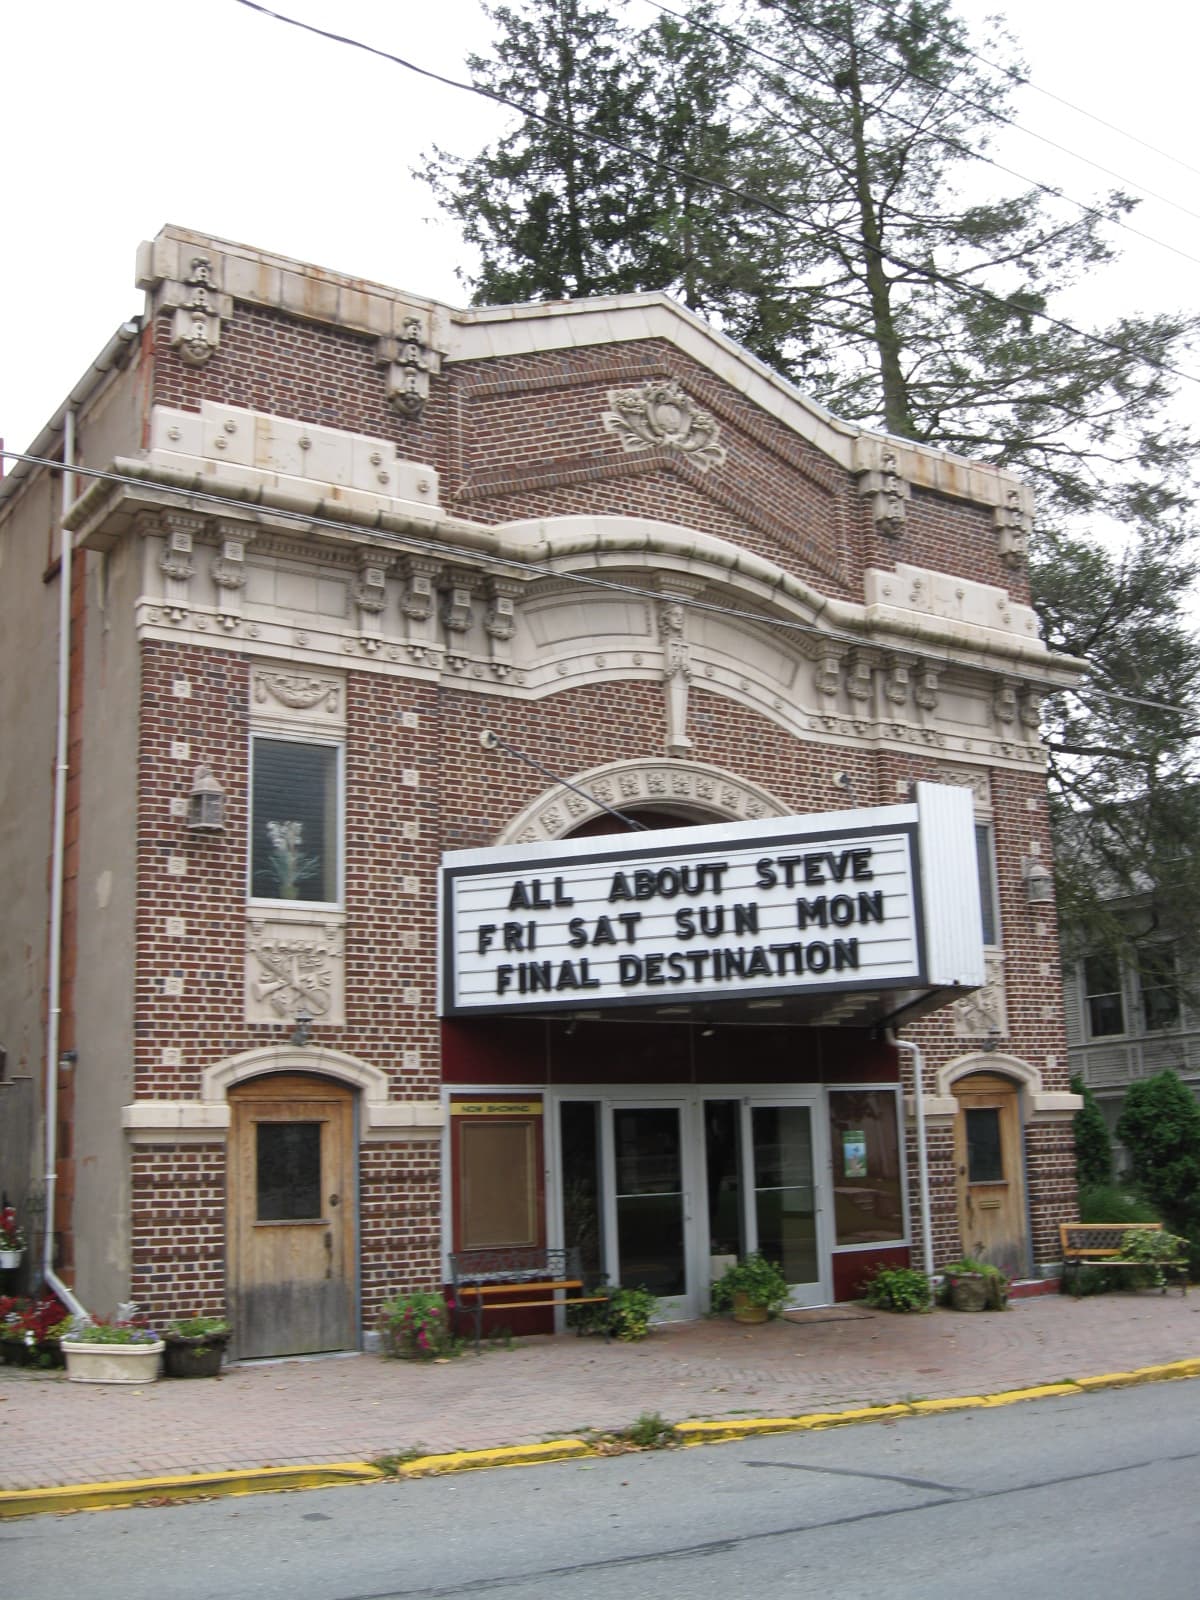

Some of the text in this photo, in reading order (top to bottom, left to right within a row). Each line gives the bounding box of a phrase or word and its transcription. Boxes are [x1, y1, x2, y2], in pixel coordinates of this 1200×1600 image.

[508, 847, 874, 911] ALL ABOUT STEVE
[478, 890, 884, 954] FRI SAT SUN MON
[497, 937, 860, 995] FINAL DESTINATION
